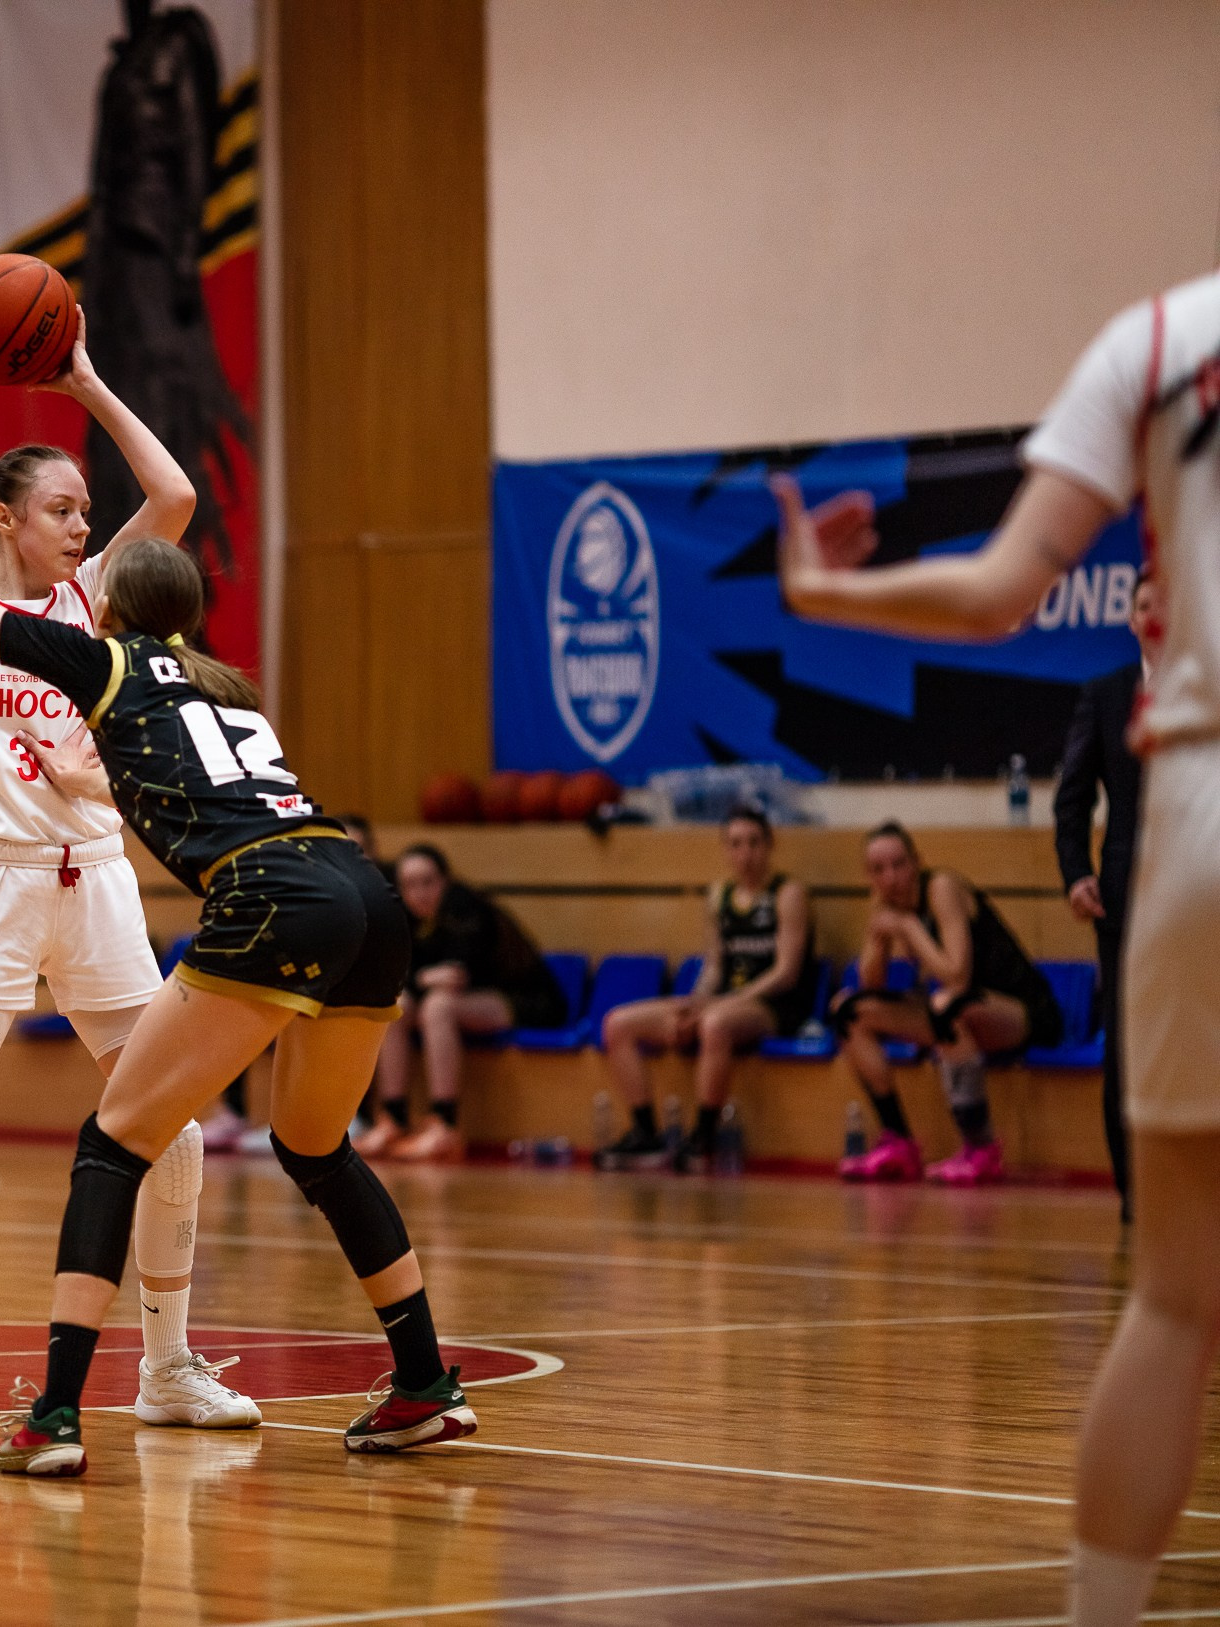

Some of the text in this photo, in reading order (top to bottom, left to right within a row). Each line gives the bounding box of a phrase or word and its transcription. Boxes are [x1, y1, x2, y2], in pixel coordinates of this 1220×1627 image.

[7, 305, 60, 377] JÖGEL
[1036, 562, 1138, 632] ONB
[179, 700, 299, 787] 12
